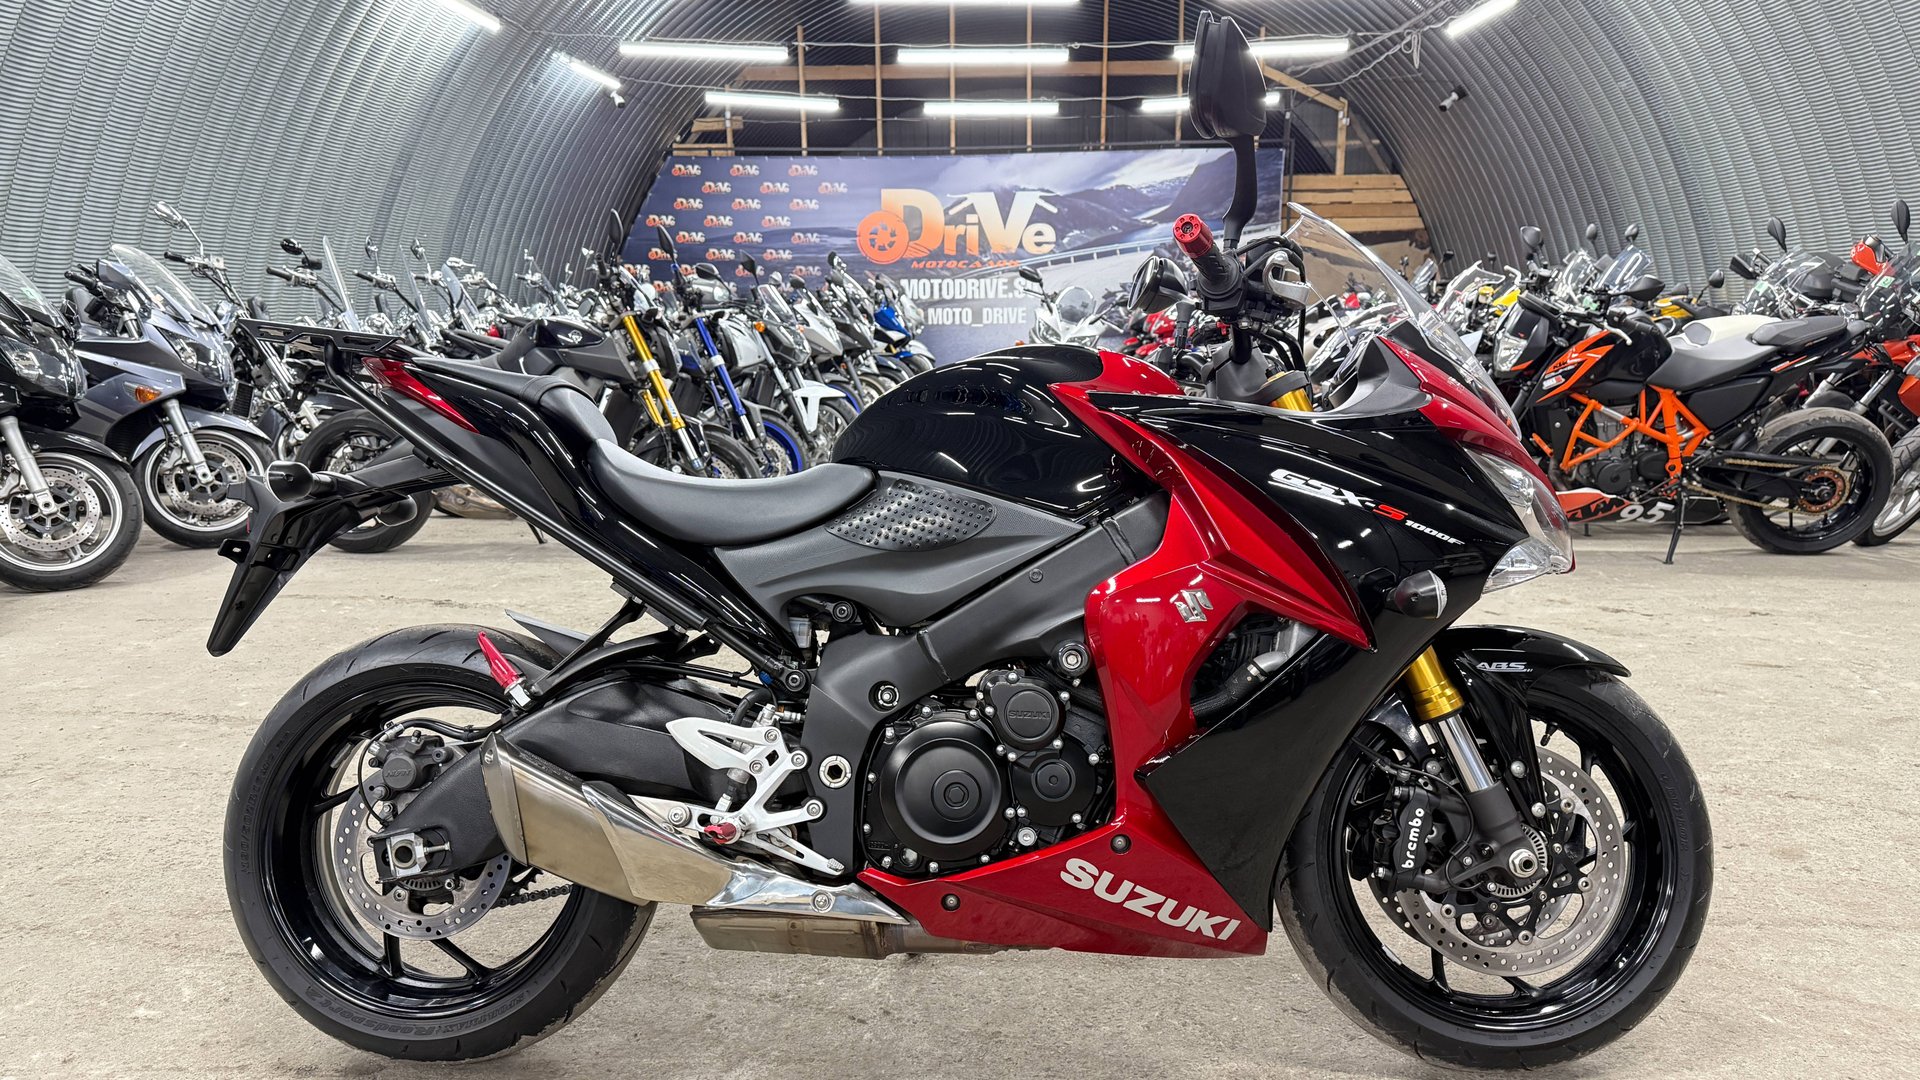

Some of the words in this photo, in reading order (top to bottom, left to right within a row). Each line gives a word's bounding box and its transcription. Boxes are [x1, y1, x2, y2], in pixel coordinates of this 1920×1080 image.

[928, 307, 1026, 327] MOTO_DRIVE
[1405, 519, 1465, 545] 1000F
[1476, 661, 1530, 672] ABS
[1008, 710, 1051, 720] SUZUKI
[1402, 807, 1425, 869] brembo
[1060, 857, 1241, 941] SUZUKI
